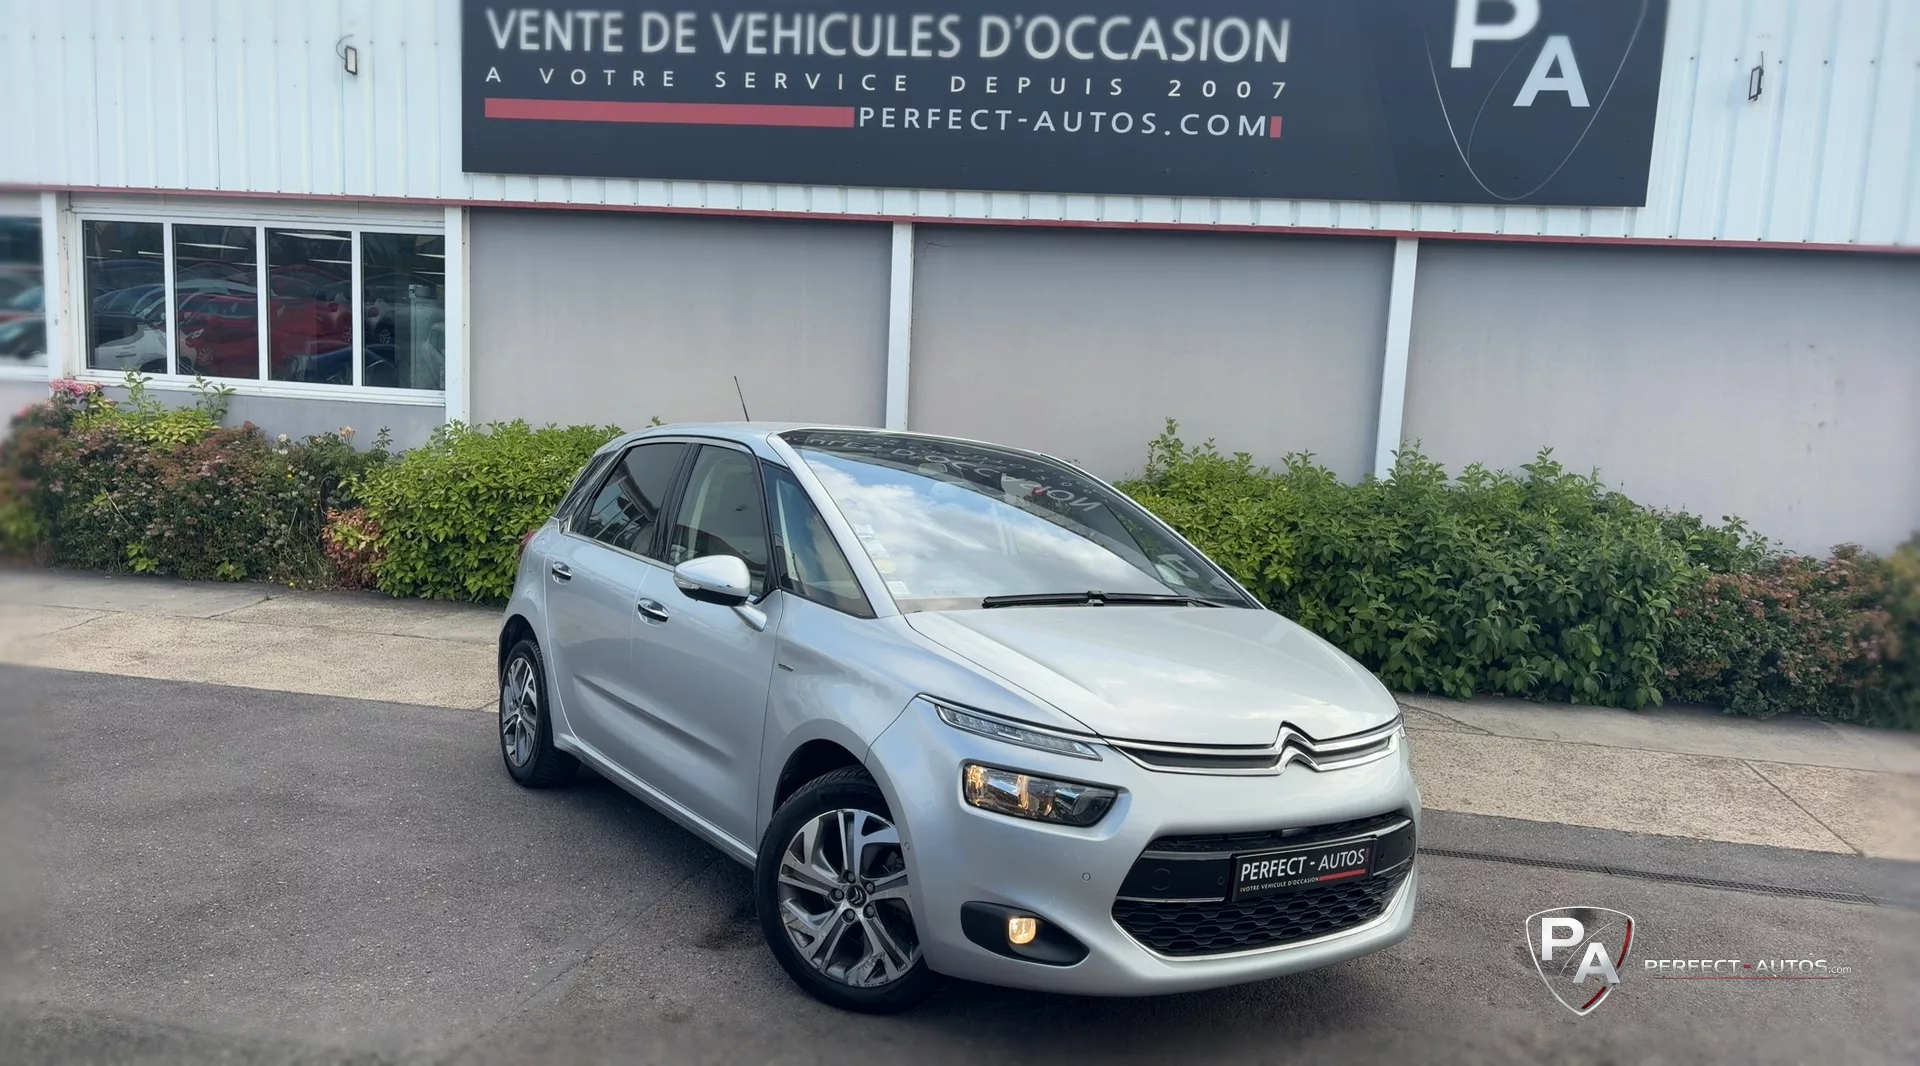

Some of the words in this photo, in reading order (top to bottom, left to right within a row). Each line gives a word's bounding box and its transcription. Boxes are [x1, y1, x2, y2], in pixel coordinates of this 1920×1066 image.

[486, 9, 623, 53] VENTE
[641, 11, 696, 54] DE
[712, 12, 961, 59] VEHICULES
[979, 15, 1290, 63] D'OCCASION
[486, 67, 502, 83] A
[539, 68, 674, 87] VOTRE
[715, 71, 907, 92] SERVICE
[951, 75, 1122, 96] DEPUIS
[1167, 79, 1286, 99] 2007
[859, 106, 1266, 137] PERFECT-AUTOS.COM
[1241, 856, 1307, 881] PERFECT
[1318, 849, 1365, 870] AUTOS
[1261, 881, 1286, 889] VEHICULE
